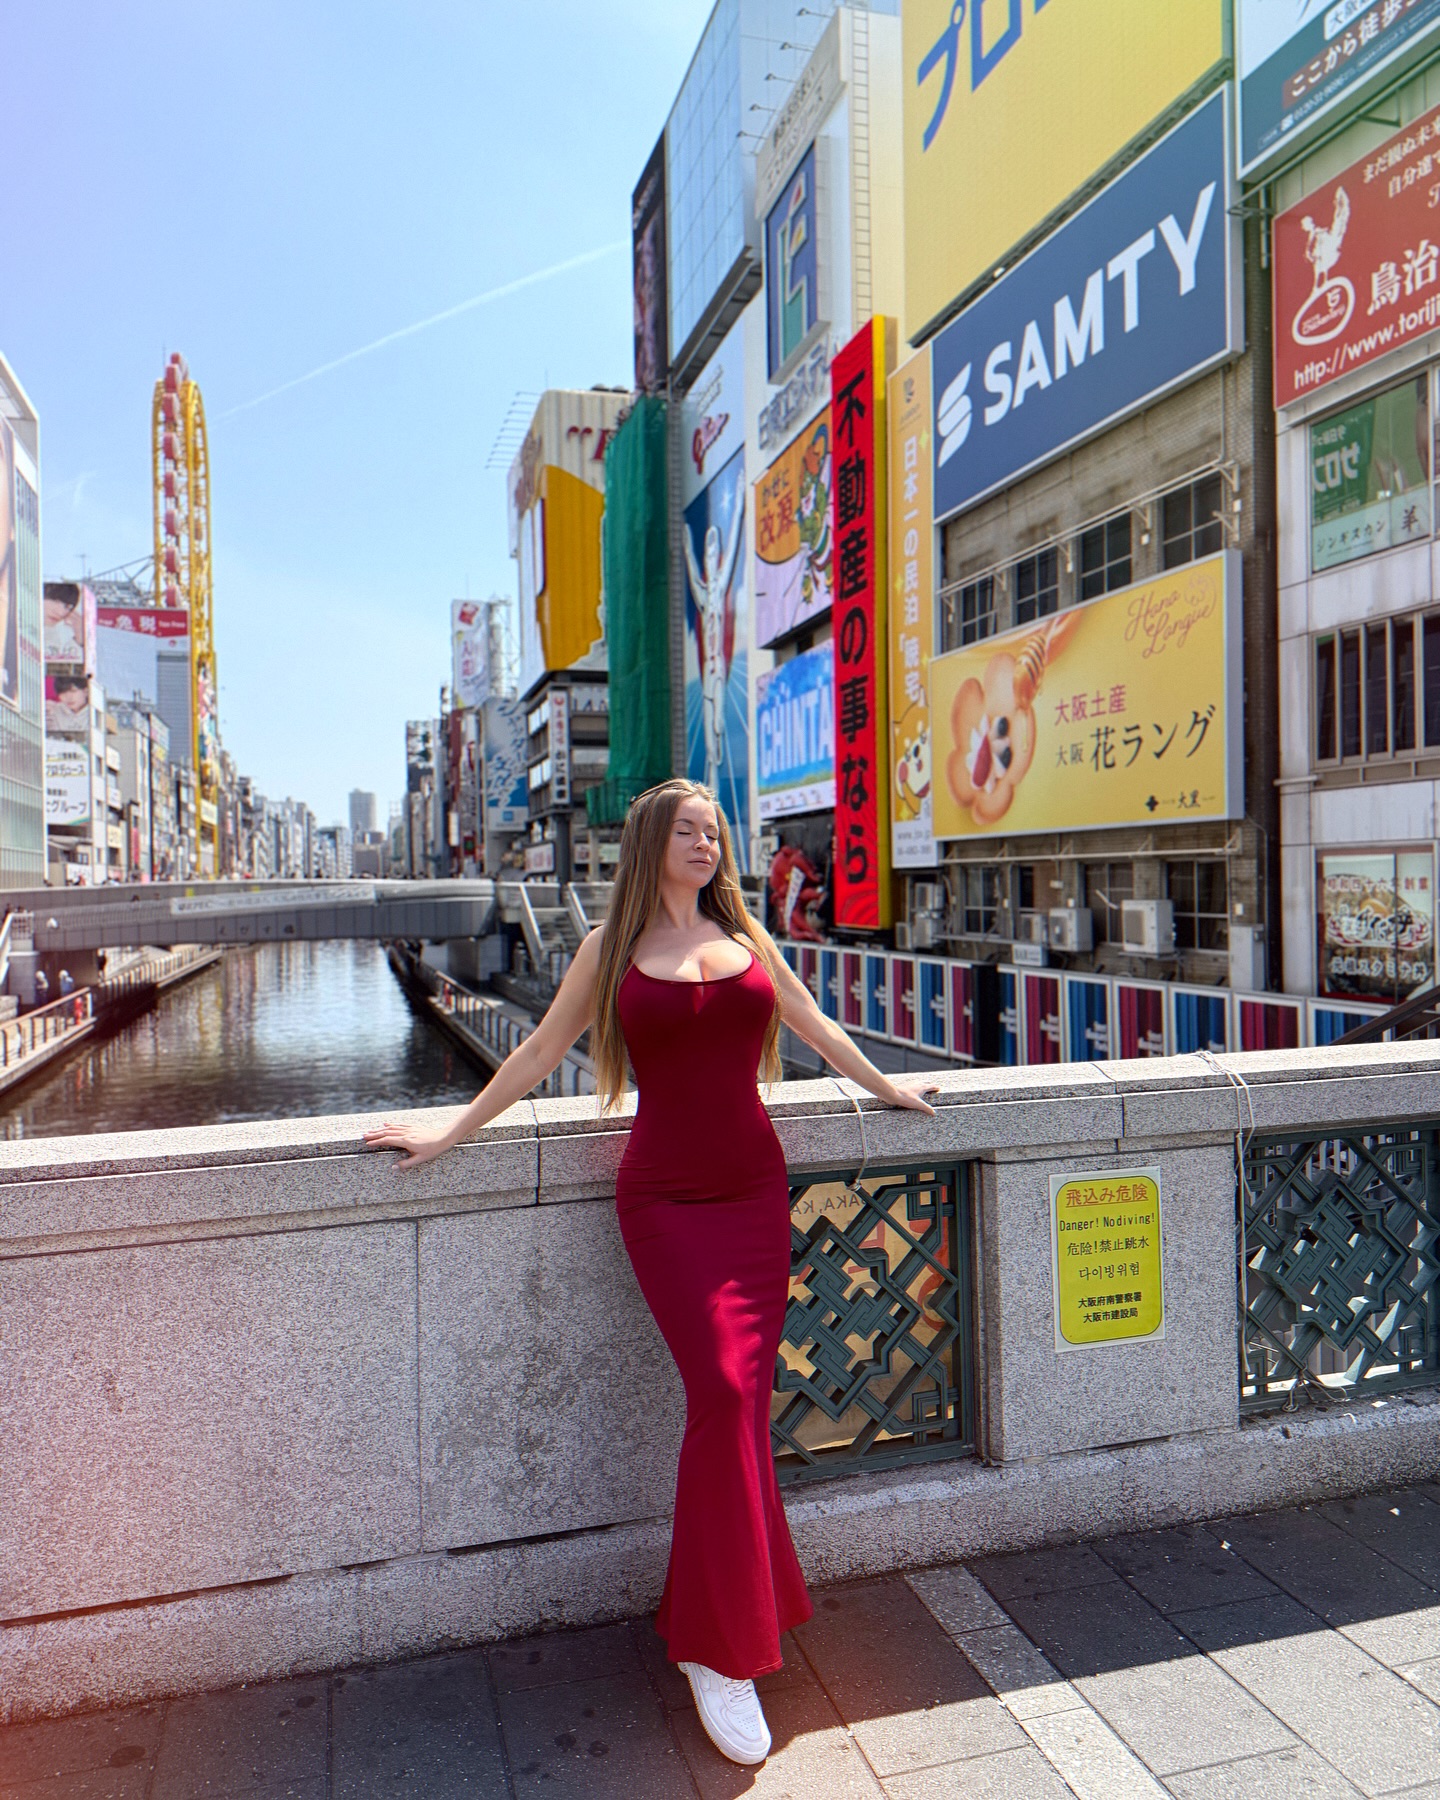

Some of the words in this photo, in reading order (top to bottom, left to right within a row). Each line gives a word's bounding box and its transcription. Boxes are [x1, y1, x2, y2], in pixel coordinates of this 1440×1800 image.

[984, 180, 1216, 427] SAMTY
[837, 369, 869, 884] 不動産の事なら
[1055, 685, 1126, 726] 大阪土産
[760, 684, 835, 780] CHINTA
[1056, 742, 1084, 768] 大阪
[1090, 704, 1216, 773] 花ラング
[1066, 1183, 1149, 1208] 飛込み危険
[1060, 1218, 1099, 1232] Danger!
[1067, 1235, 1149, 1256] 危险!禁止跳水
[1079, 1261, 1140, 1281] 다이빙위험
[1078, 1291, 1142, 1309] 大阪府南警察署
[1083, 1307, 1138, 1324] 大阪市建設局
